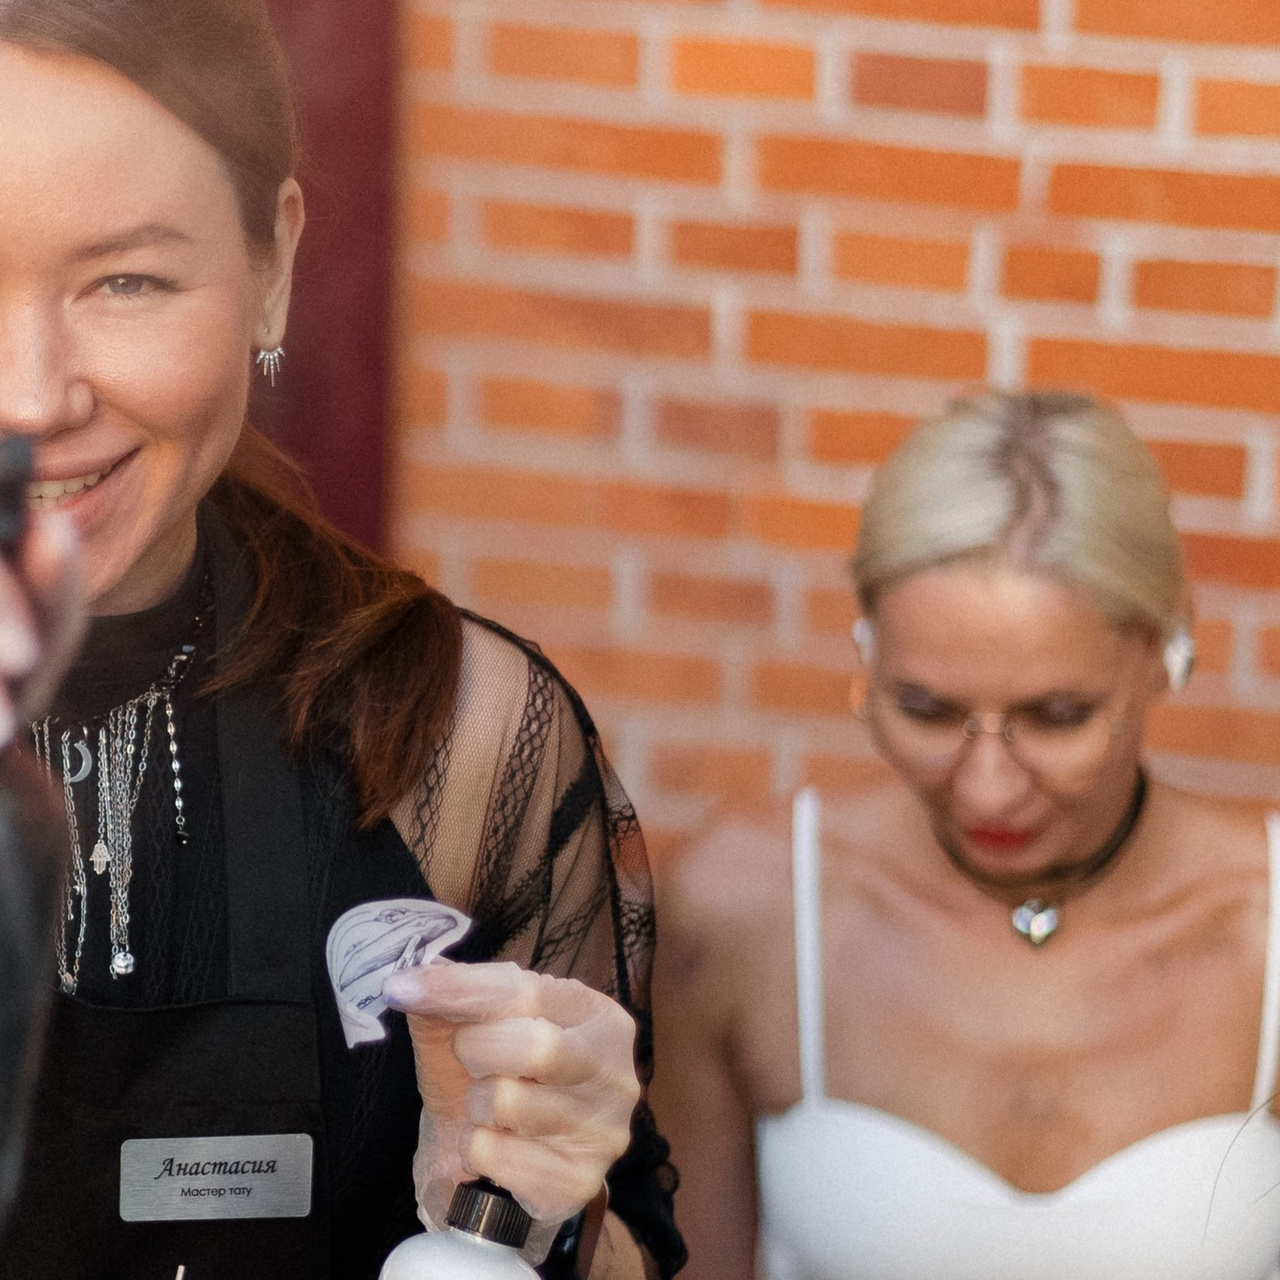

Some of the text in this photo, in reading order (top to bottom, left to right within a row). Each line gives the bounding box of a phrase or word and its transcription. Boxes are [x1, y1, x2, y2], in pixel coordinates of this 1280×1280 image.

[154, 1157, 277, 1180] Анастасия
[181, 1186, 252, 1198] Мастер тату
